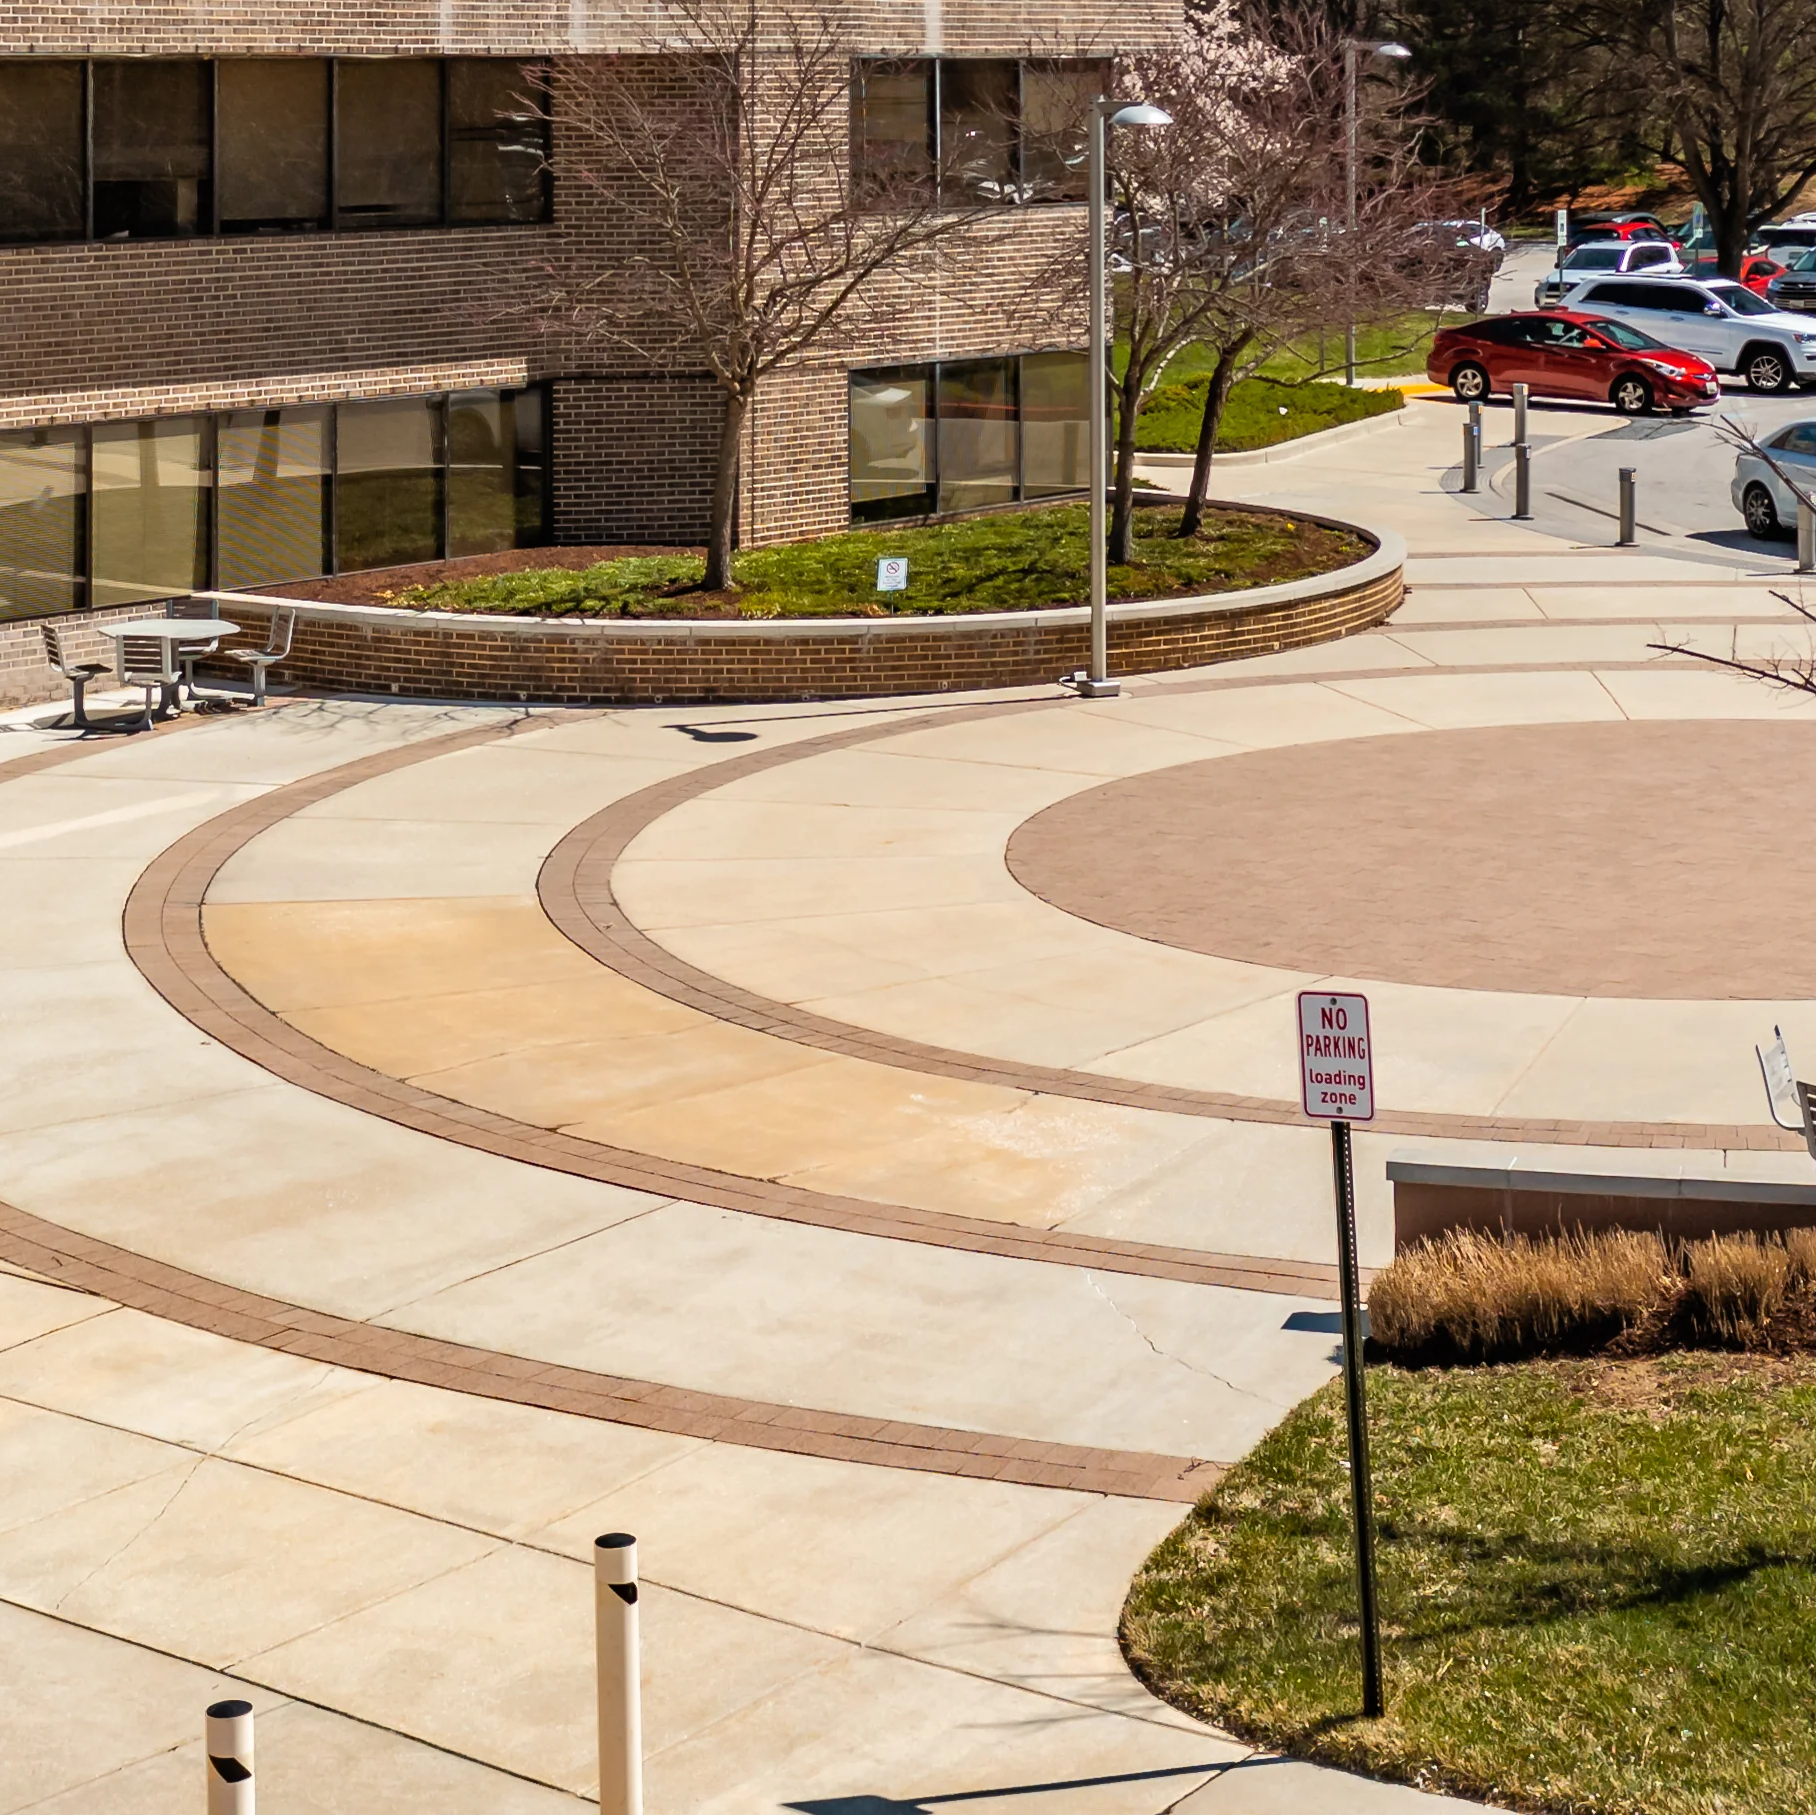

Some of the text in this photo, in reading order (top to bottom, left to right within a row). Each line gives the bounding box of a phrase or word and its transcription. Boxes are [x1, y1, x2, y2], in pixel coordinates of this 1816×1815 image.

[1321, 1007, 1347, 1030] NO
[1305, 1034, 1365, 1059] PARKING
[1309, 1068, 1366, 1090] loading
[1320, 1091, 1357, 1105] zone
